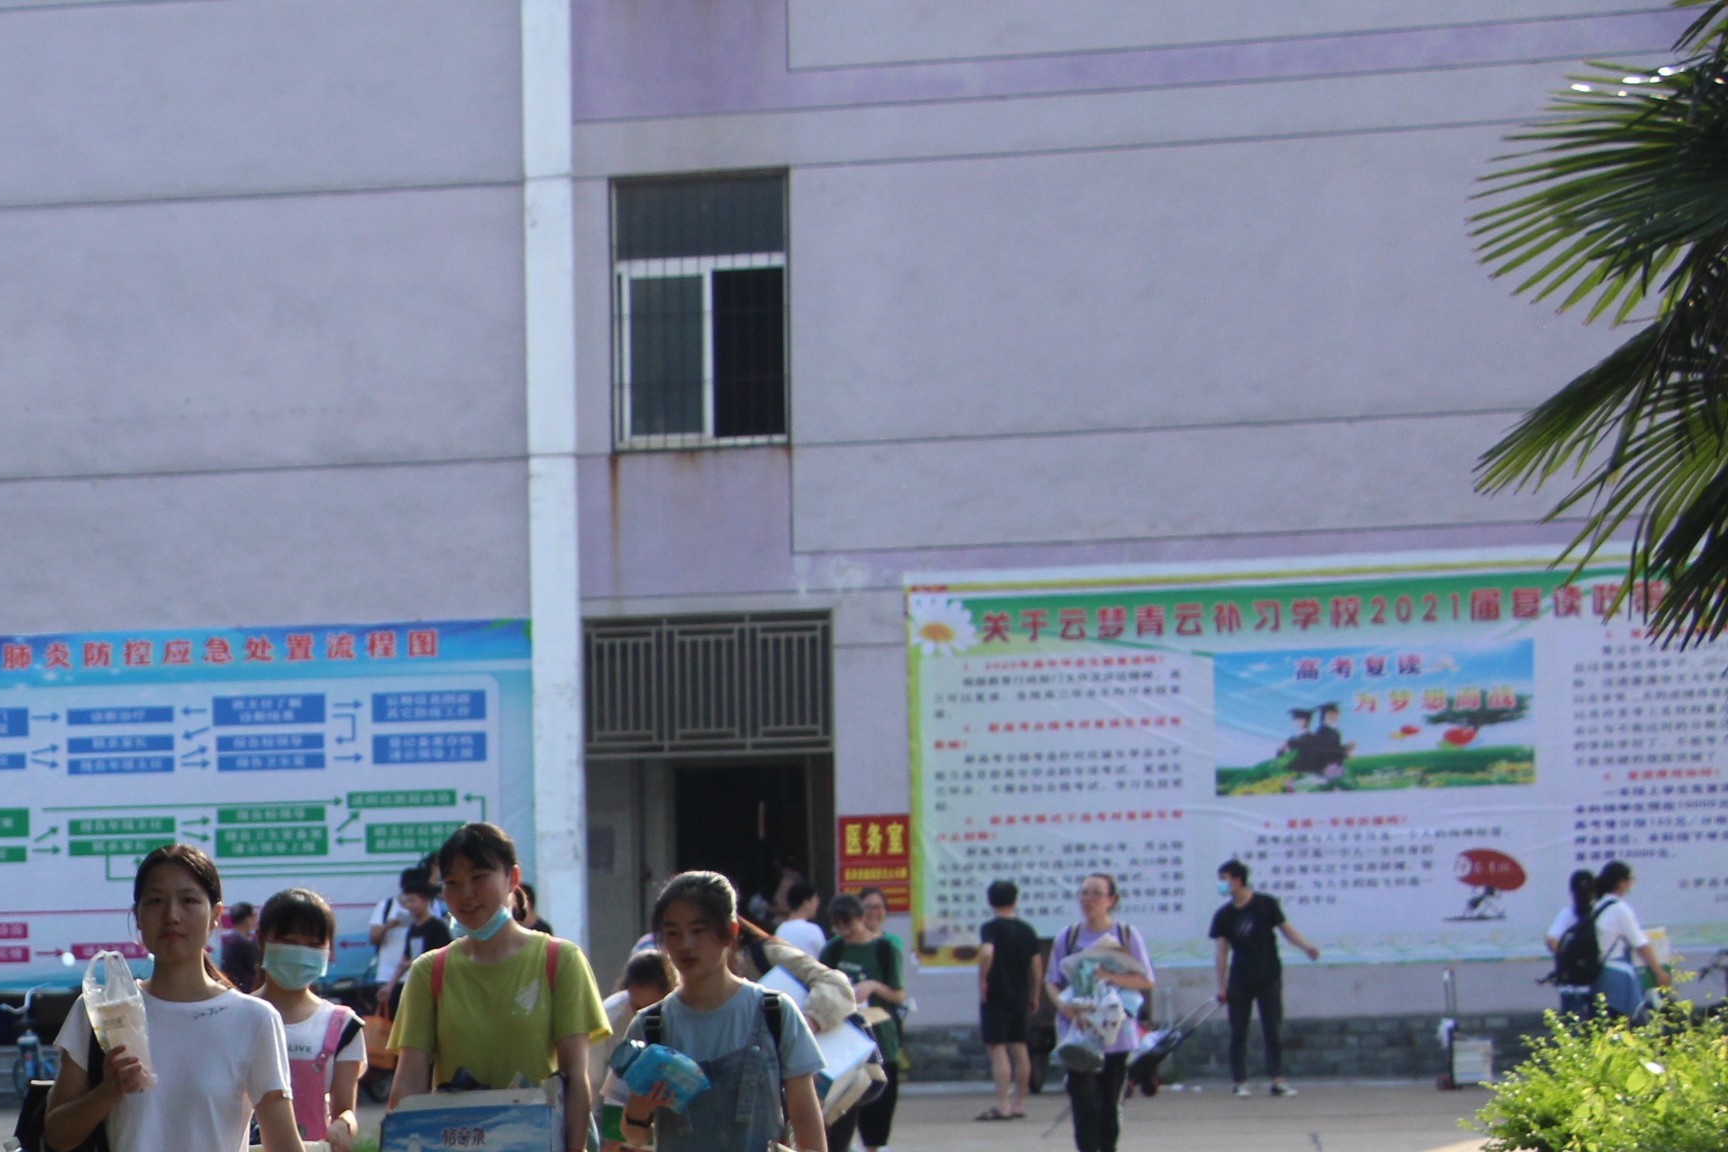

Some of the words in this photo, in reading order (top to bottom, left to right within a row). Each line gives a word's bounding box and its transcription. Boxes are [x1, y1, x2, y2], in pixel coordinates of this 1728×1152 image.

[1295, 654, 1422, 681] 高考复读
[845, 821, 905, 855] 医务室
